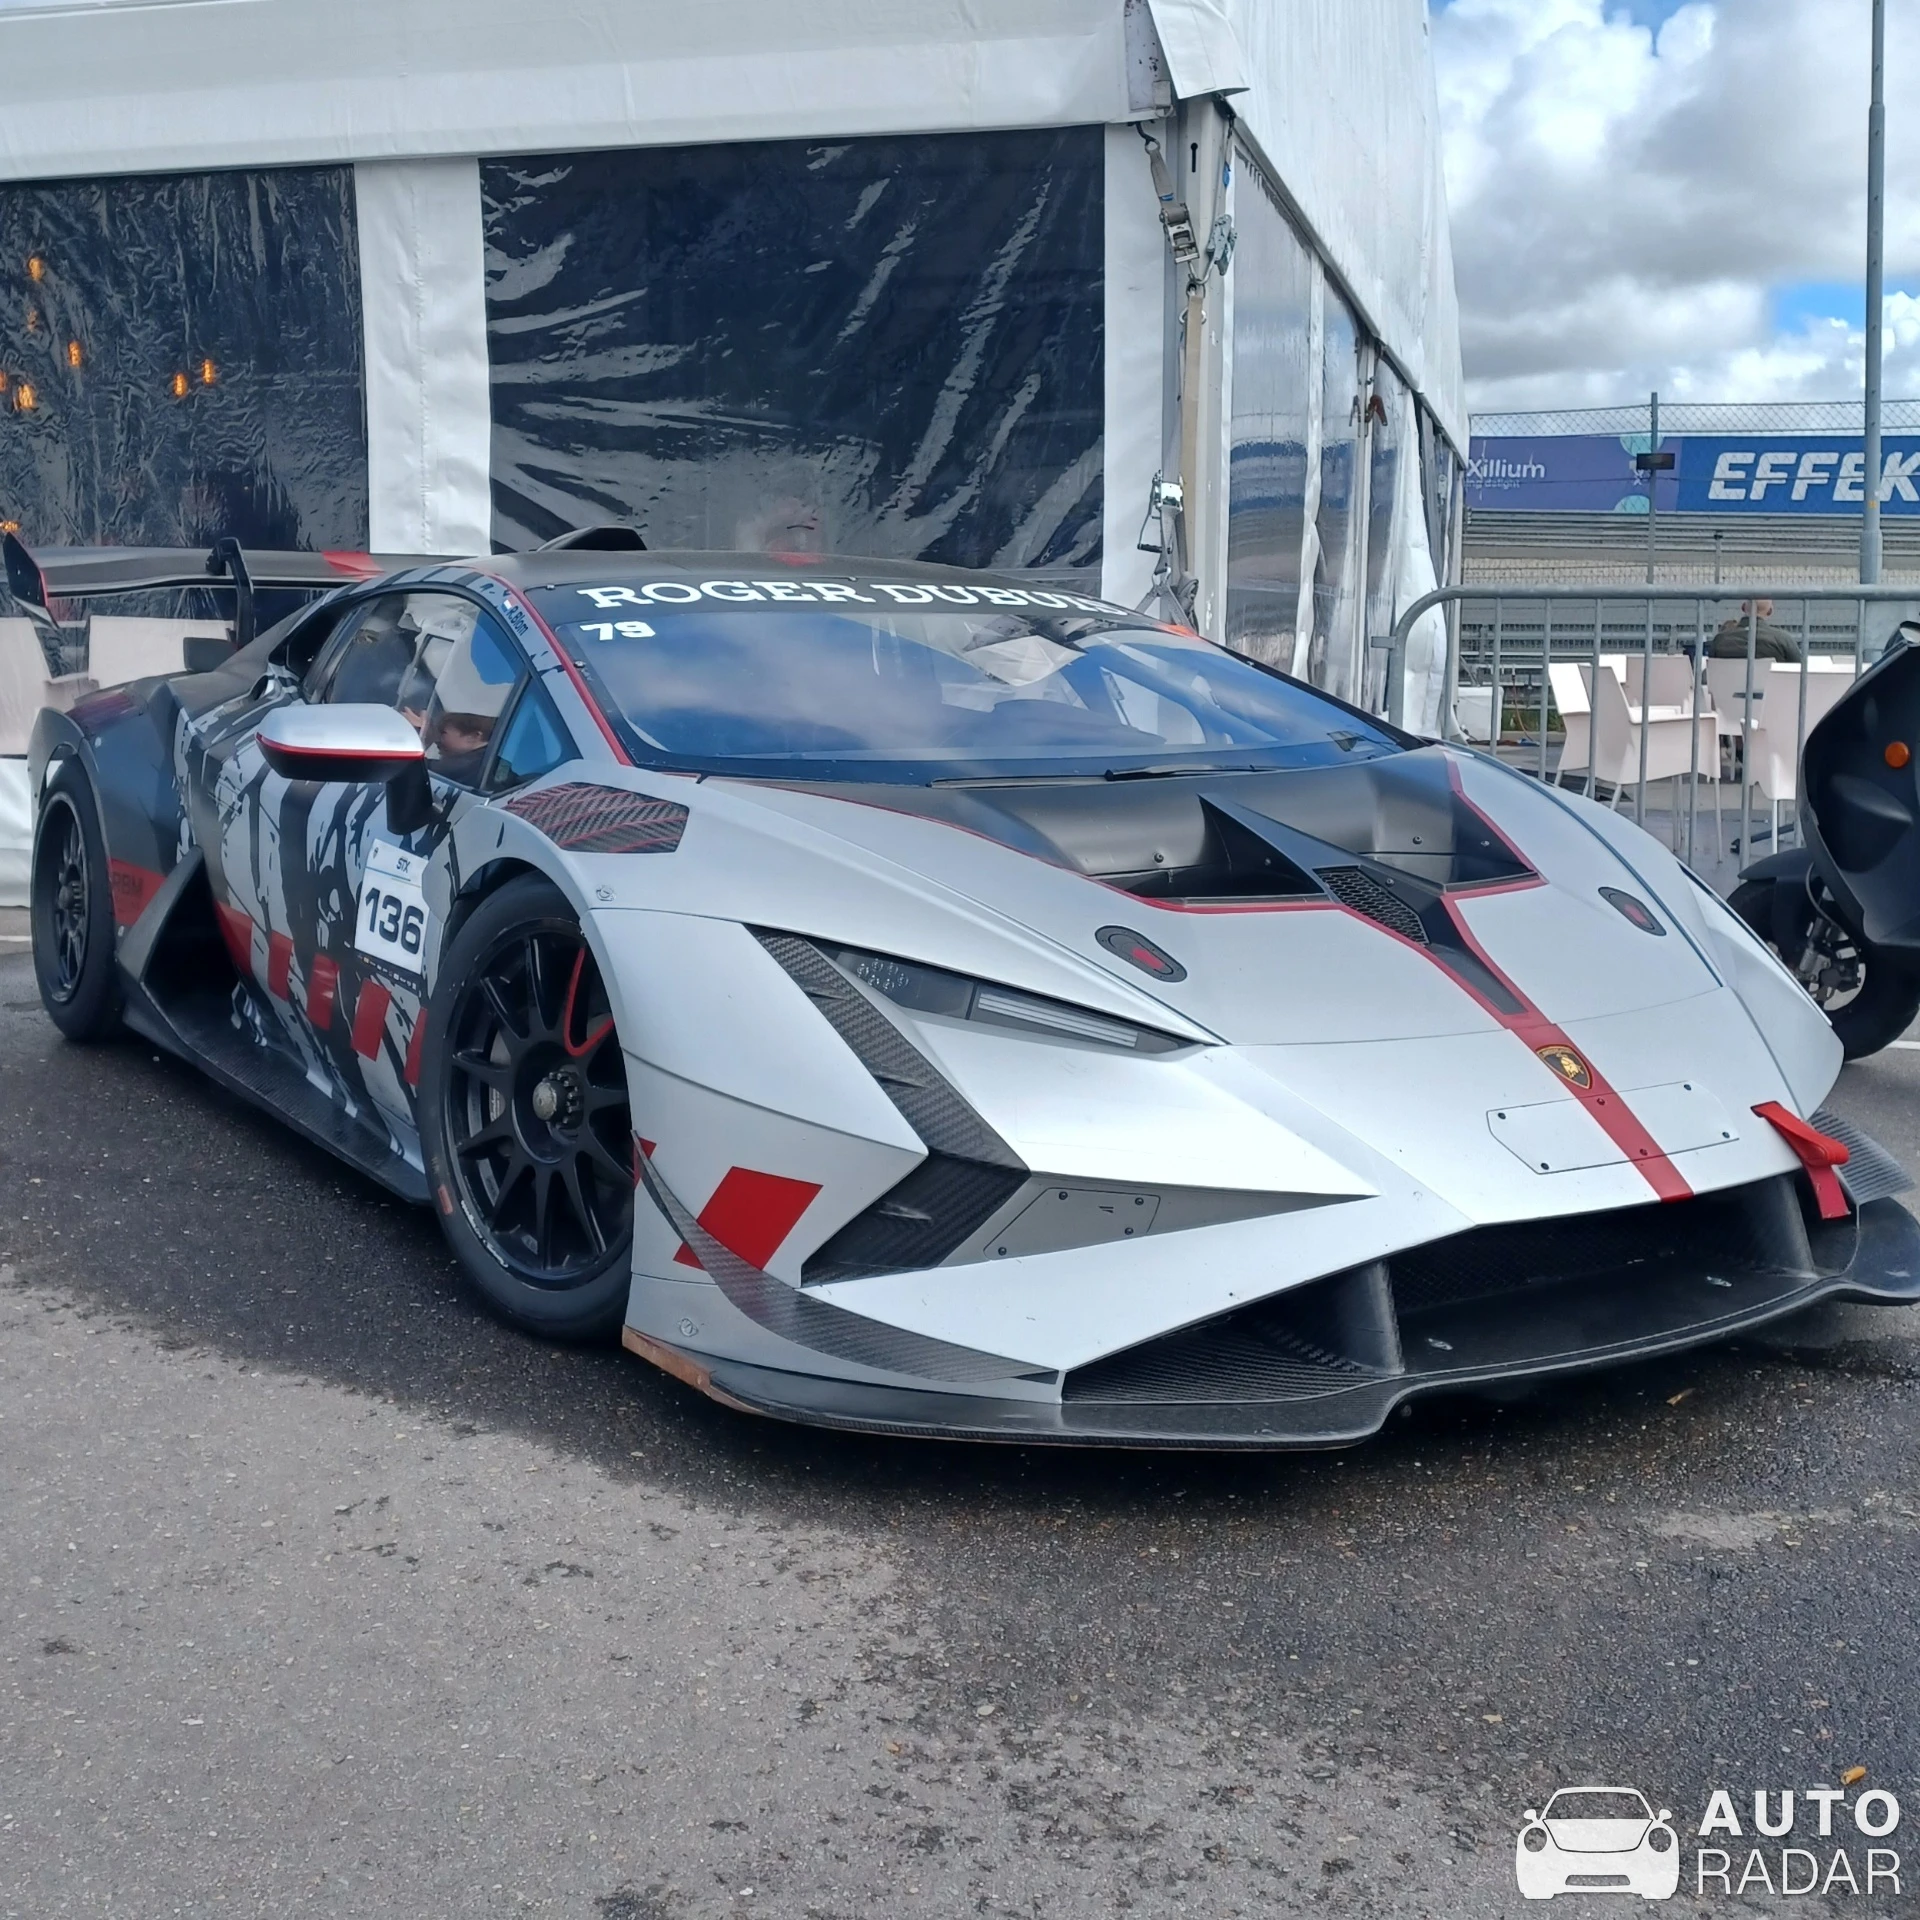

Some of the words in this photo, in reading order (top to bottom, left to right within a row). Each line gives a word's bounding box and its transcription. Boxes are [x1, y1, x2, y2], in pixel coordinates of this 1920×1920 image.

[1708, 452, 1920, 502] EFFEK
[576, 580, 876, 609] ROGER
[579, 620, 656, 641] 79
[396, 856, 411, 875] STX
[365, 887, 425, 955] 136
